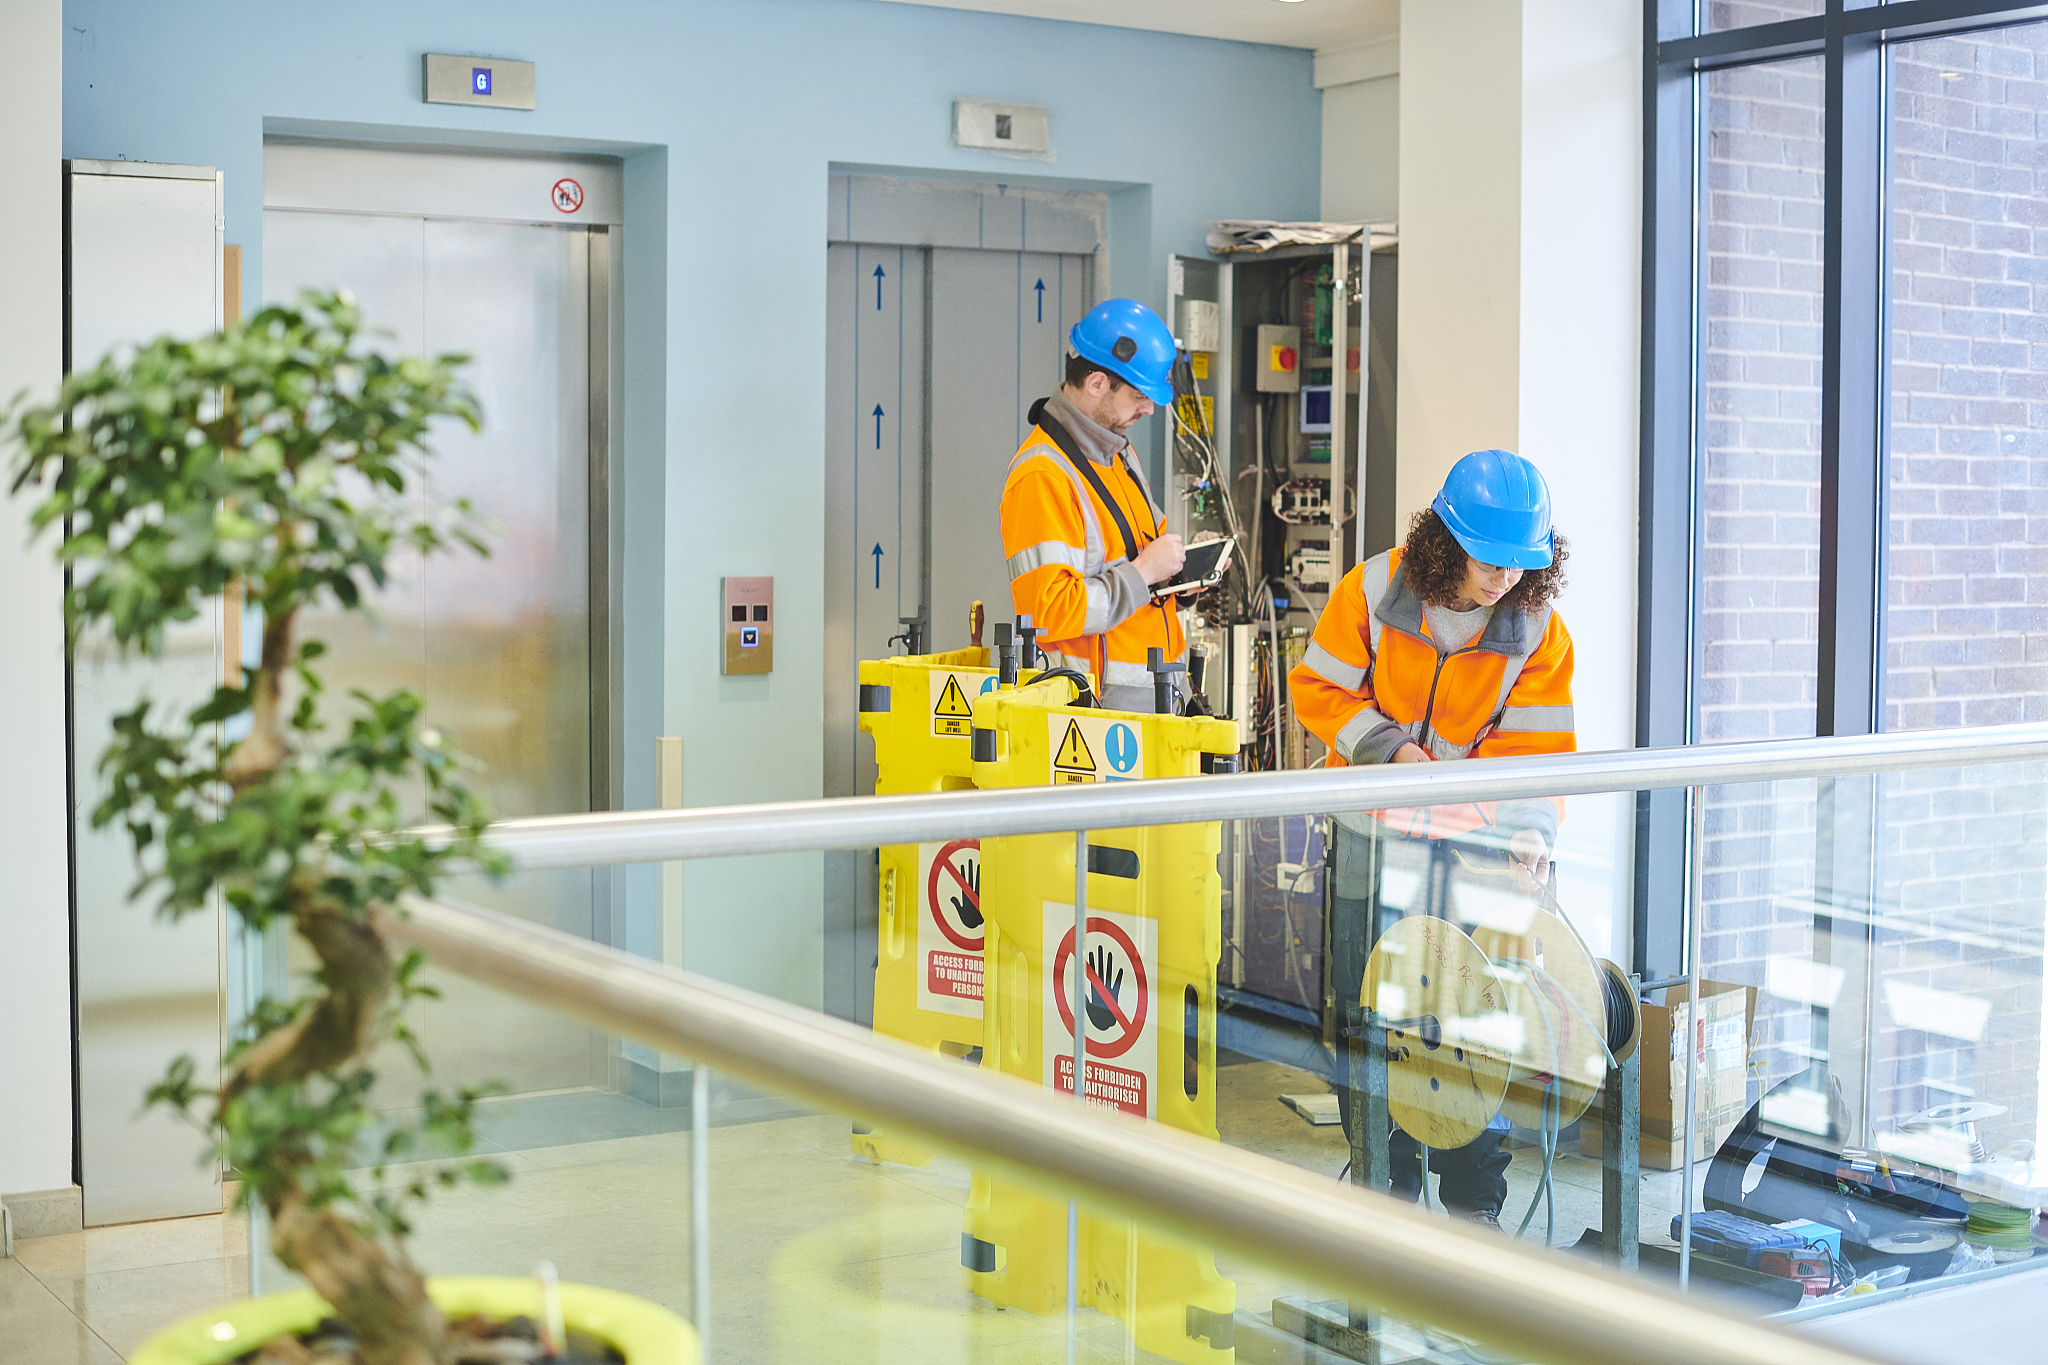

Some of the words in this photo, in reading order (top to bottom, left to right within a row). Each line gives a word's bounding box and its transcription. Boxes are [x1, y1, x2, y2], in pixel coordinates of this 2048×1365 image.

[476, 73, 487, 90] G
[1067, 774, 1082, 783] DANGER
[933, 954, 963, 968] ACCESS
[935, 967, 945, 979] TO
[1458, 965, 1474, 987] PVC
[1060, 1060, 1092, 1078] ACS
[1094, 1067, 1140, 1090] FORBIDDEN
[1062, 1075, 1074, 1090] TO
[1085, 1081, 1138, 1104] AUTHORISED
[1084, 1096, 1119, 1116] ERSONS
